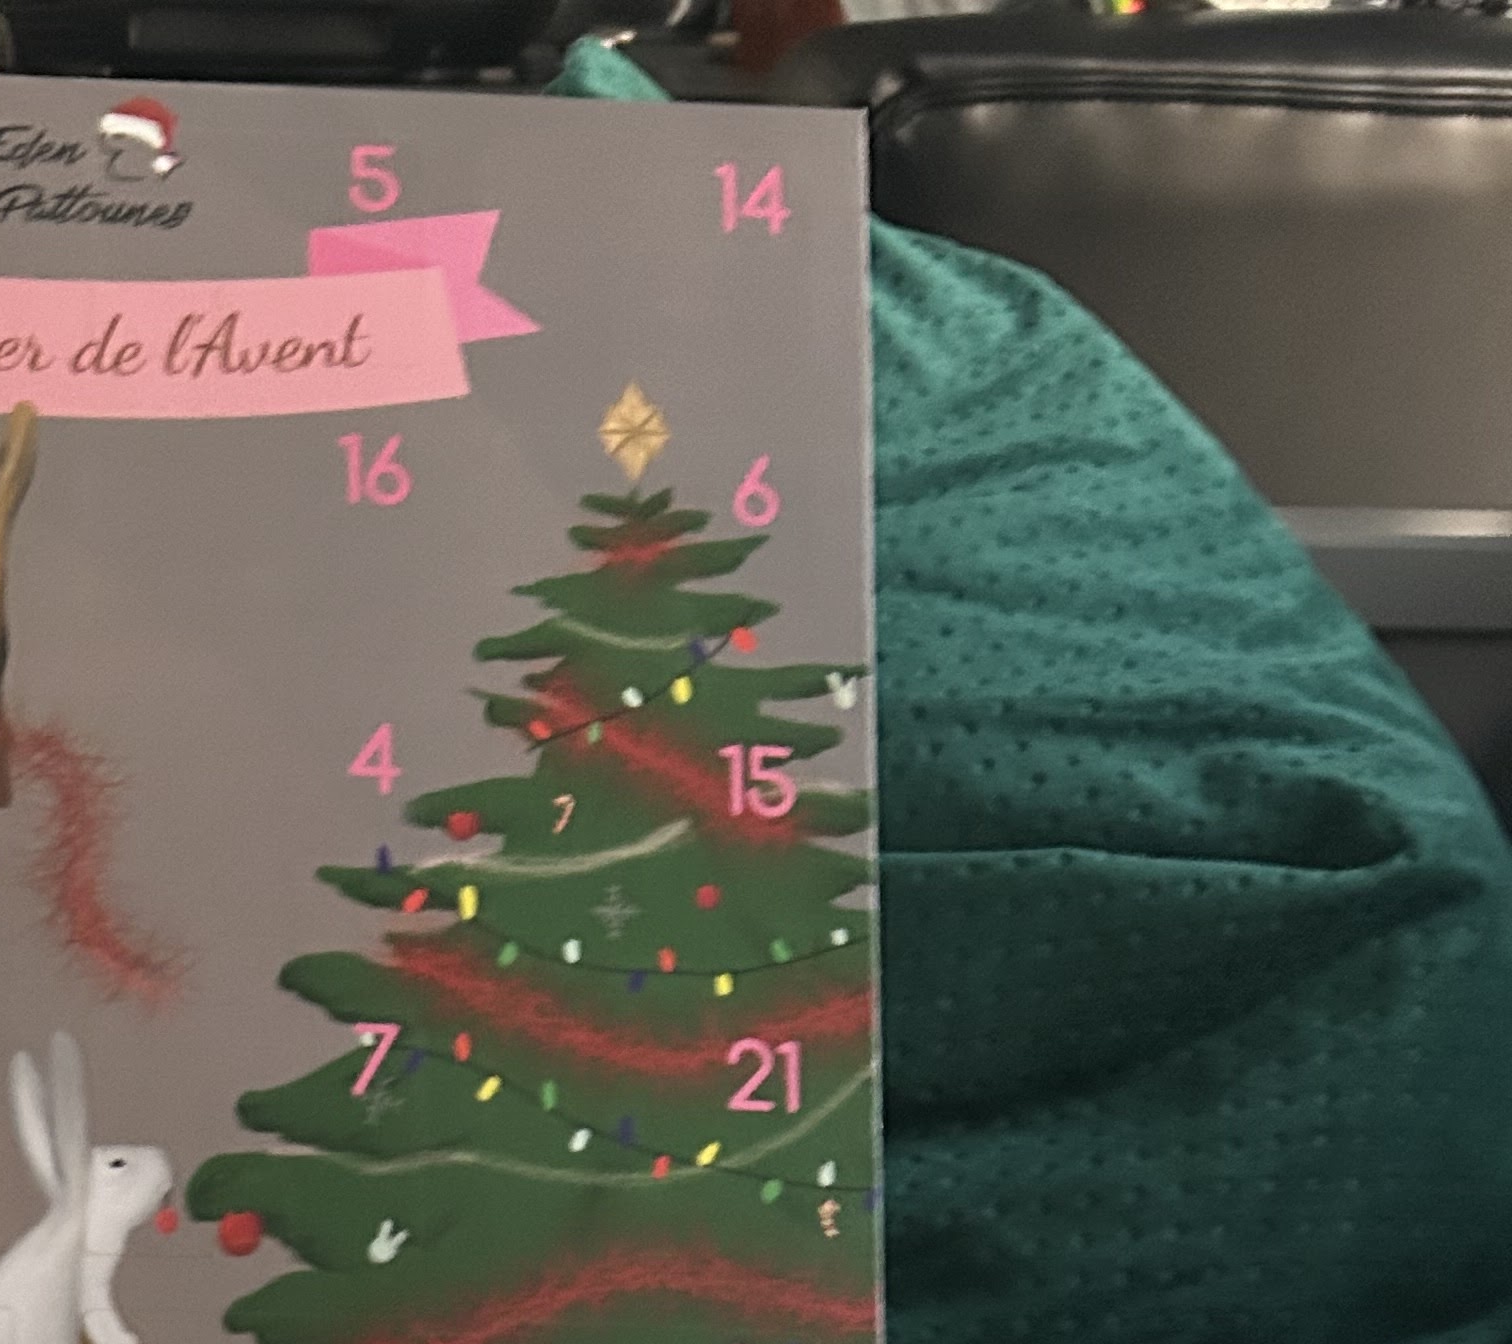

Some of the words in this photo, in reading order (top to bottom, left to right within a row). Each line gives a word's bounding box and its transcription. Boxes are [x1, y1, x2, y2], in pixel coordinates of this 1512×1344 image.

[348, 146, 400, 212] 5
[714, 164, 791, 235] 14
[71, 313, 145, 375] de
[163, 312, 371, 378] l'Avent
[338, 434, 413, 506] 16
[733, 456, 781, 527] 6
[349, 722, 401, 795] 4
[718, 744, 797, 818] 15
[351, 1023, 401, 1097] 7
[726, 1038, 802, 1114] 21
